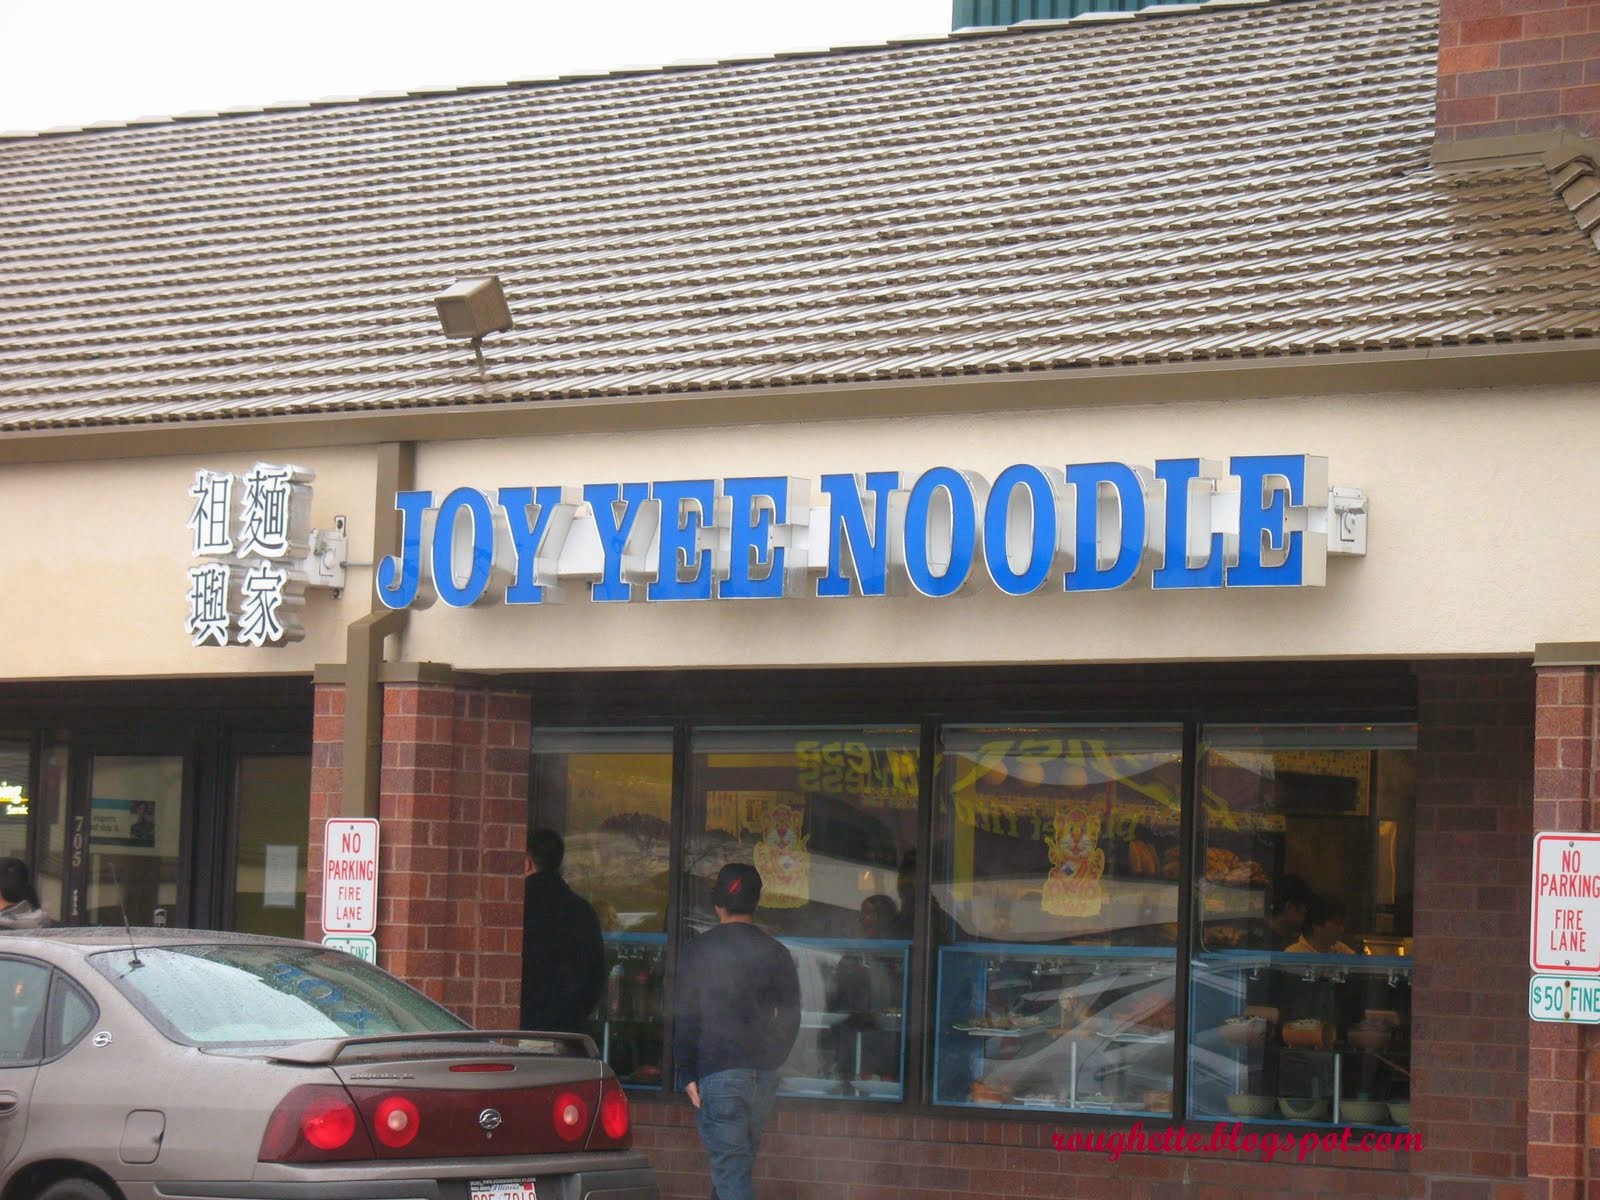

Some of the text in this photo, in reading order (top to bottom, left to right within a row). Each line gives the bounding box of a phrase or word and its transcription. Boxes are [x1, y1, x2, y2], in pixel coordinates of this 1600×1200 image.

[376, 454, 1307, 609] JOY YEE NOODLE
[72, 815, 84, 868] 705
[341, 832, 362, 854] NO
[328, 859, 374, 881] PARKING
[1561, 850, 1581, 873] NO
[338, 886, 361, 901] FIRE
[1540, 873, 1600, 899] PARKING
[336, 906, 363, 921] LANE
[1555, 909, 1584, 931] FIRE
[1550, 931, 1587, 952] LANE
[1533, 986, 1600, 1013] $50 FINE
